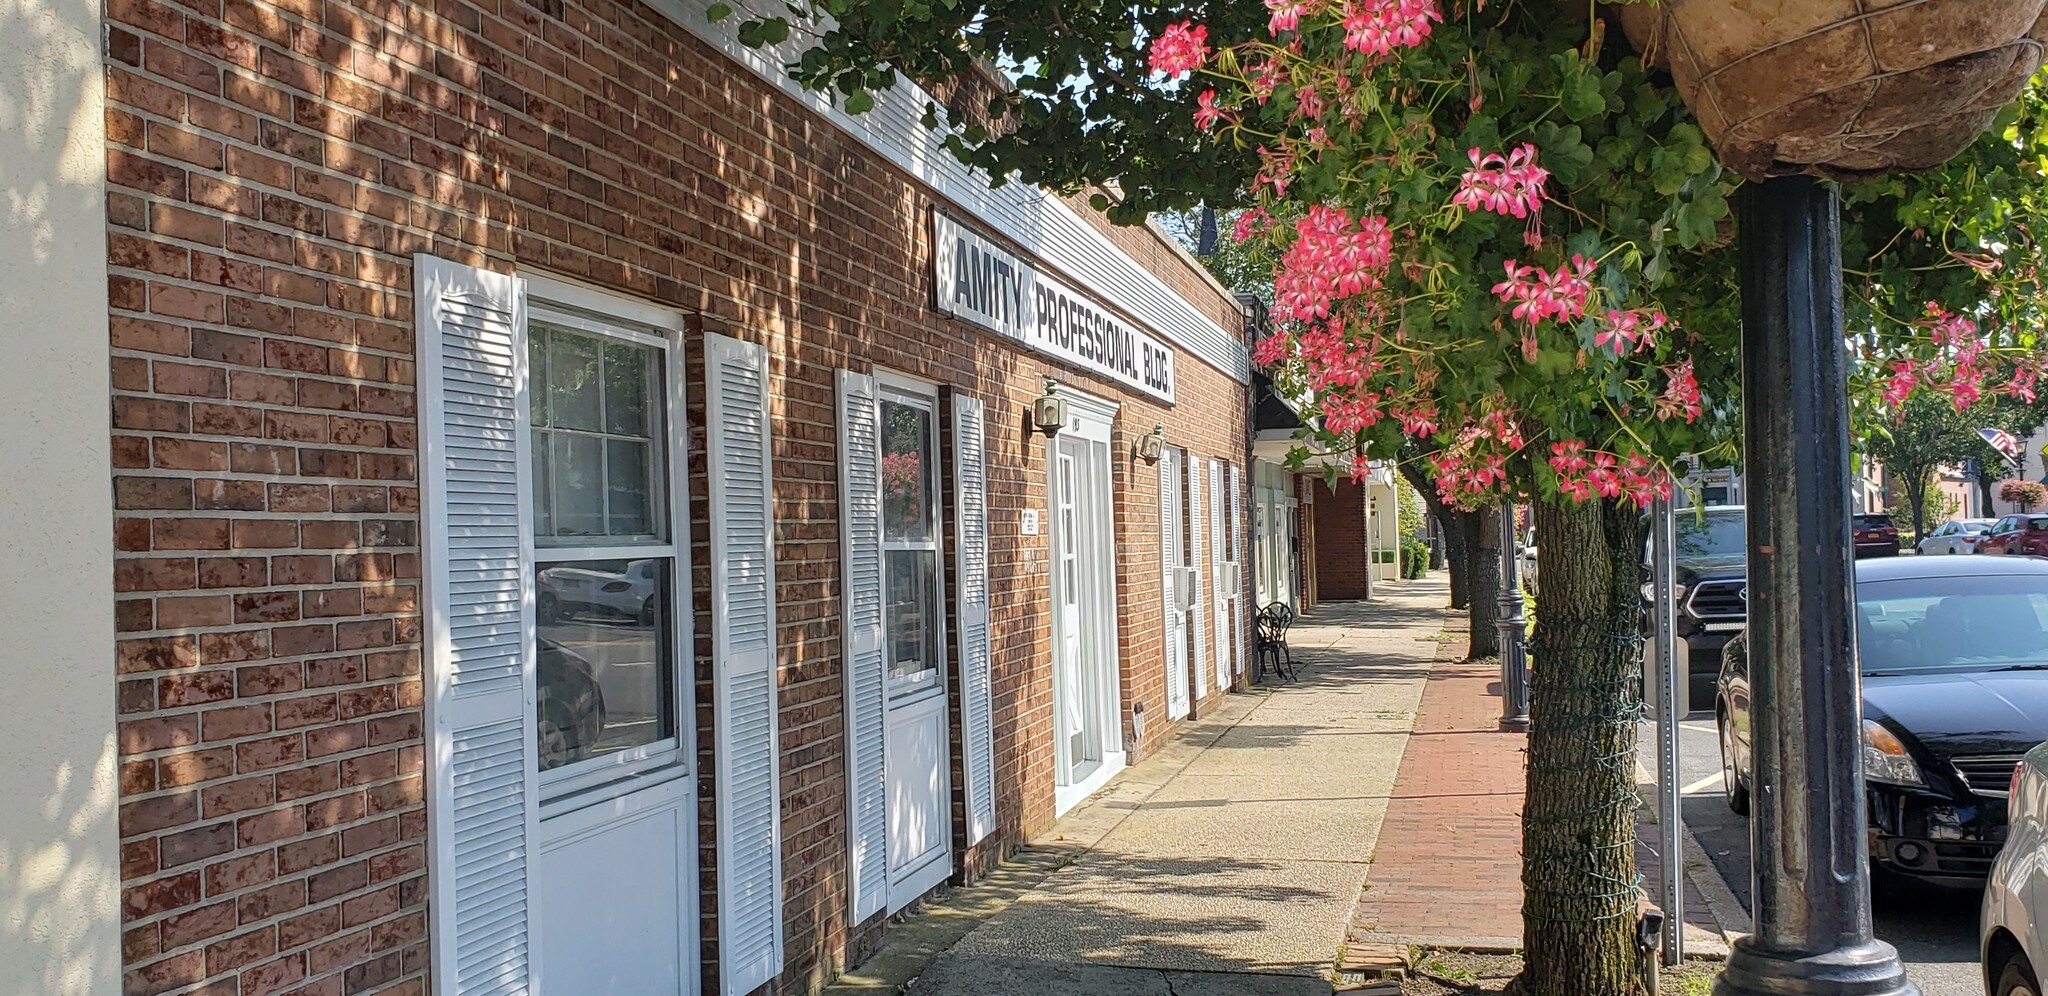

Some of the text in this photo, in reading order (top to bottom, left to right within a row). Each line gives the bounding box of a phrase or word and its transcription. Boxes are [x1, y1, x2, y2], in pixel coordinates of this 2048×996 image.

[955, 237, 1171, 395] AMITY PROFESSIONAL BLDG.
